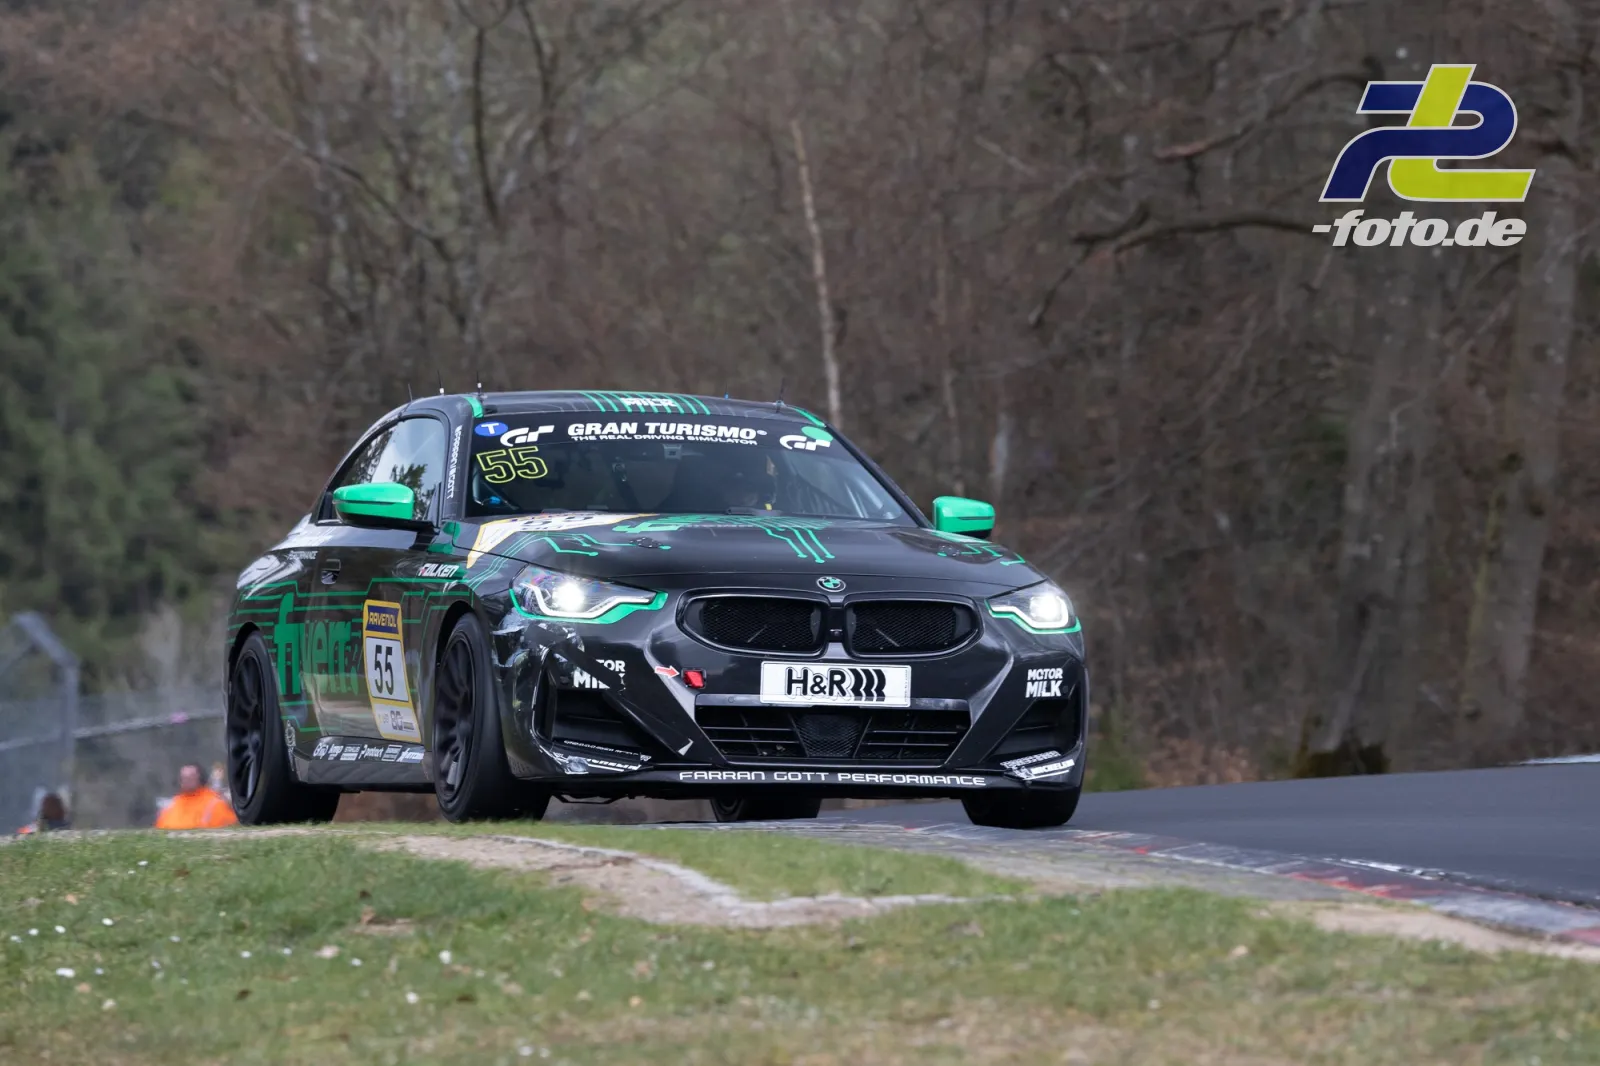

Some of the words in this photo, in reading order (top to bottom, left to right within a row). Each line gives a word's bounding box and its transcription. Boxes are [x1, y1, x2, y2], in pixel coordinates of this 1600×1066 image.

[567, 422, 638, 436] GRAN
[687, 436, 758, 446] SIMULATOR
[476, 446, 548, 484] 55
[369, 611, 397, 628] RAVENOL
[374, 644, 394, 696] 55
[1027, 668, 1064, 681] MOTOR
[785, 667, 850, 699] H&R
[1025, 680, 1063, 698] MILK
[679, 771, 765, 781] FARRAN
[773, 772, 829, 781] GOTT
[838, 772, 987, 786] PERFORMANCE
